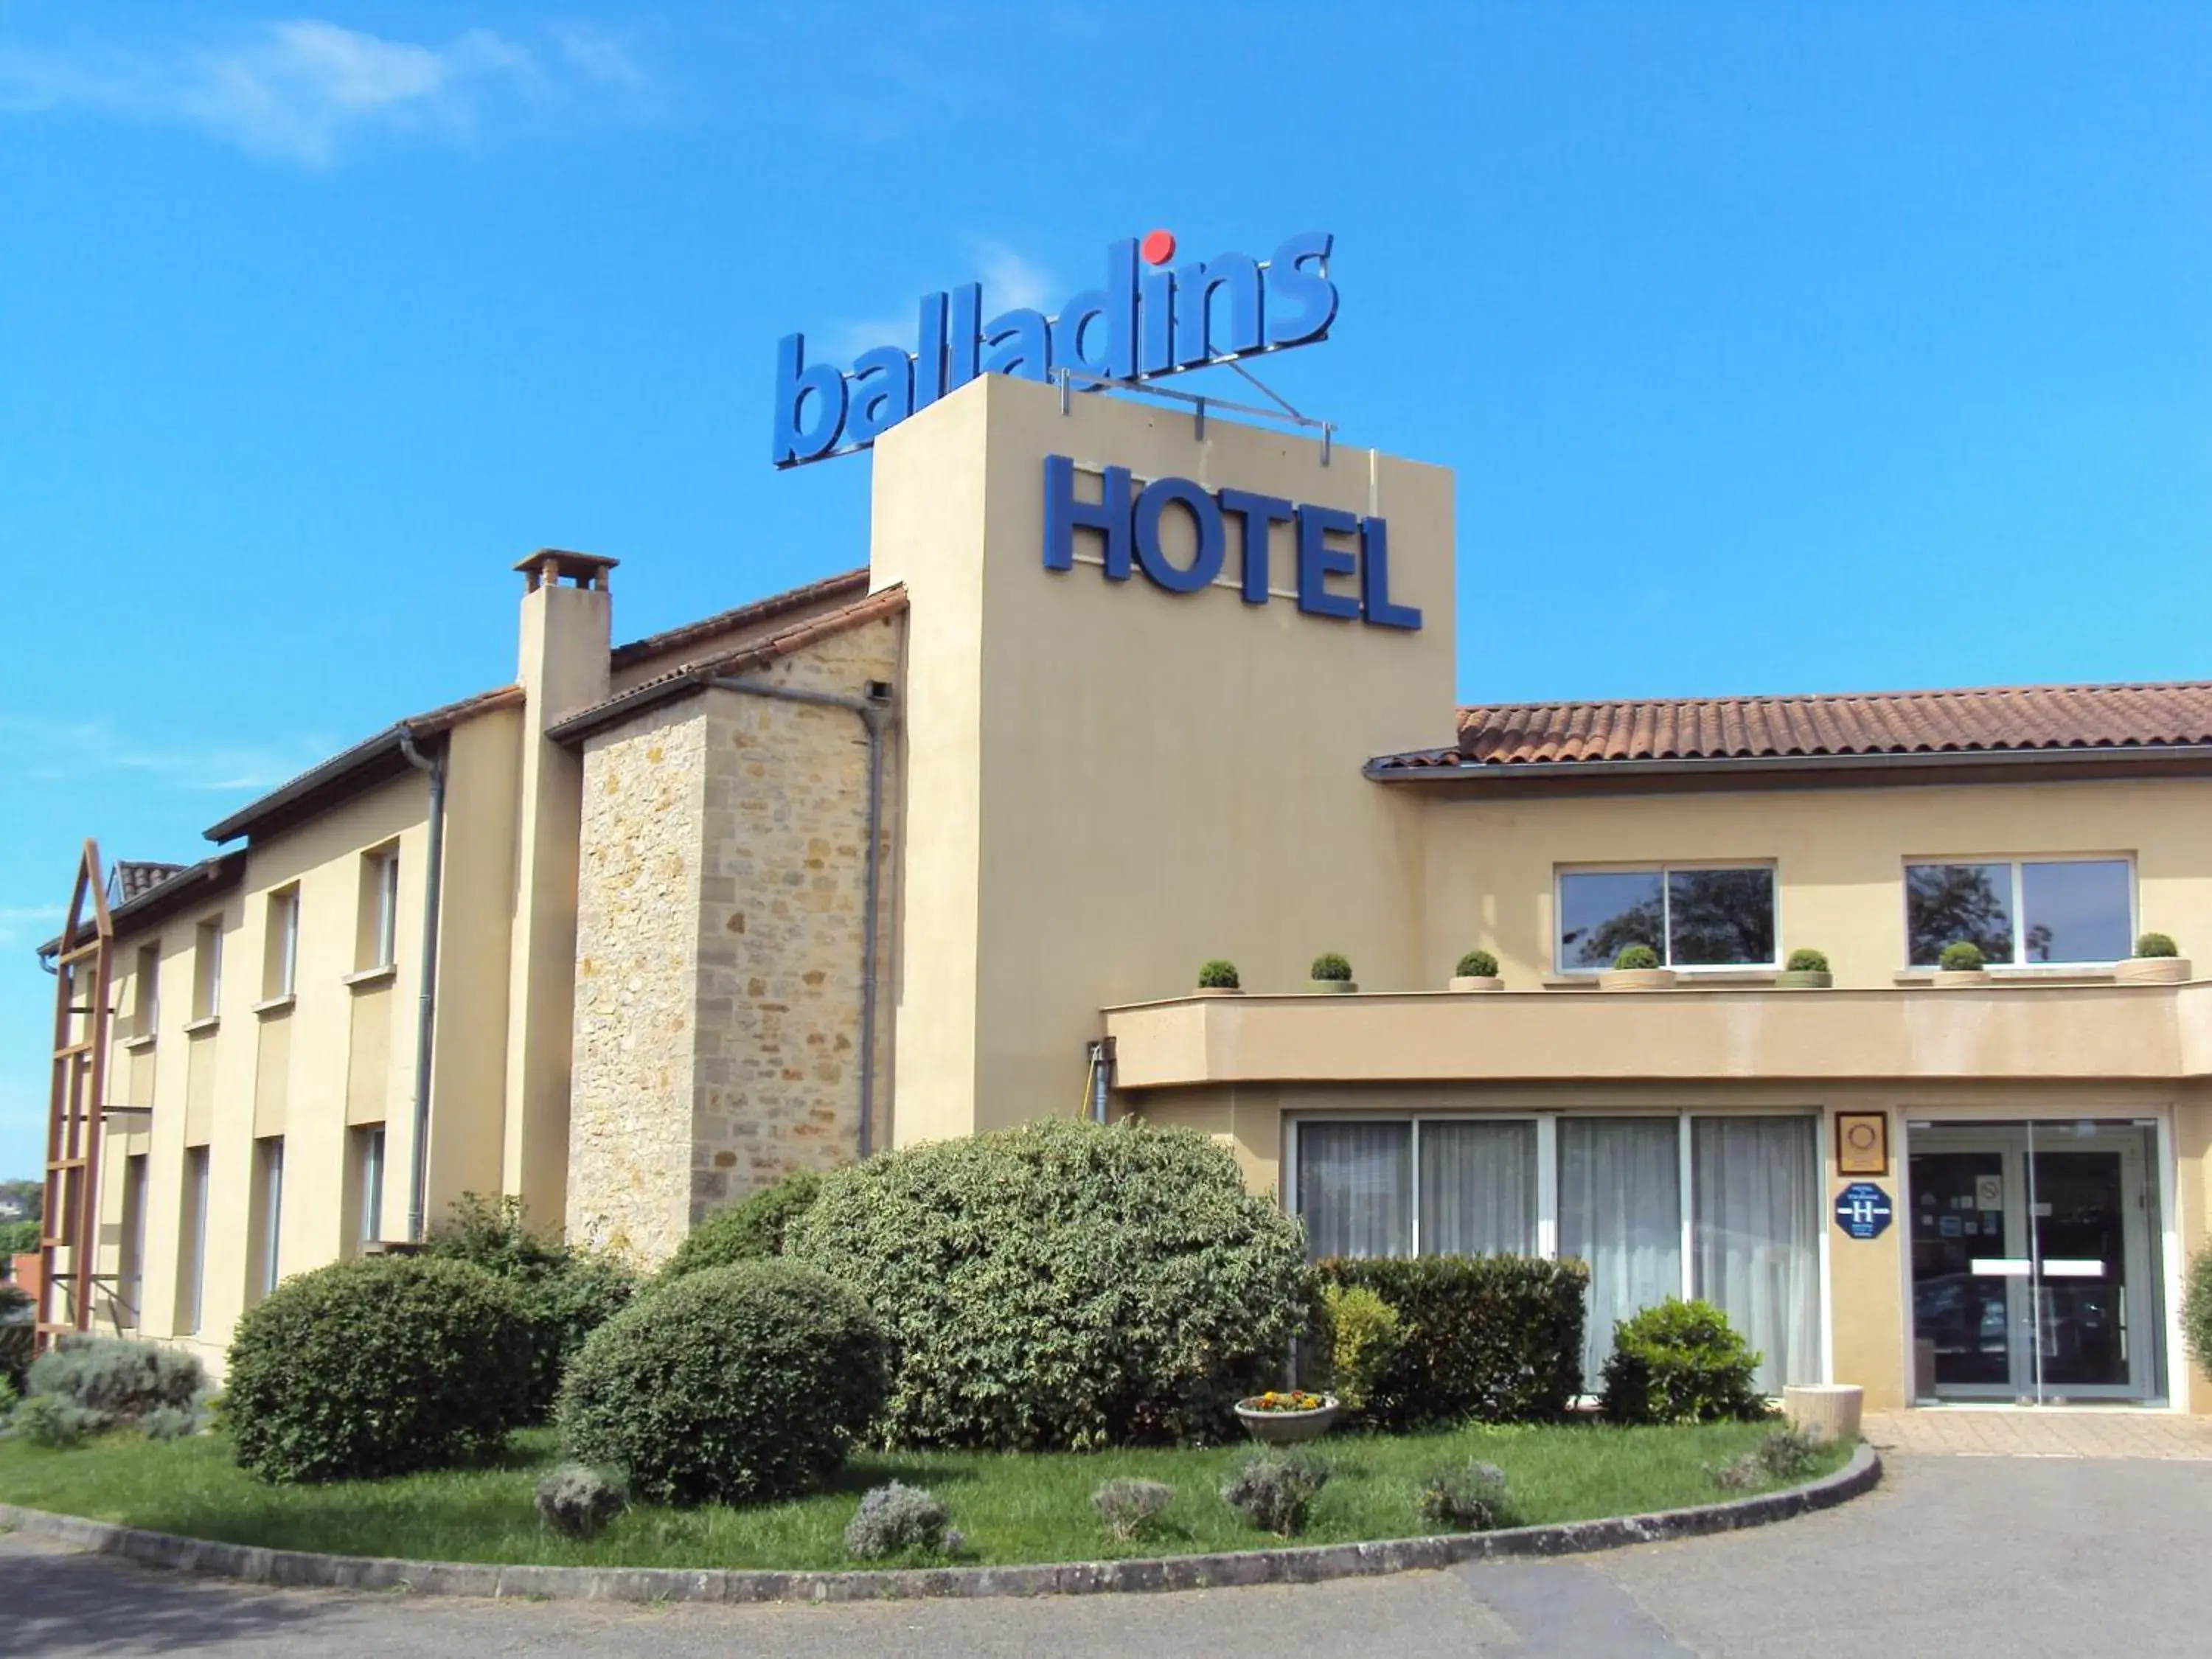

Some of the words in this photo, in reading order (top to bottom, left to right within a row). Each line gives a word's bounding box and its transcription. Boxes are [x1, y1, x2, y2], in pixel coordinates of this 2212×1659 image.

[772, 229, 1339, 467] balladins
[1043, 454, 1422, 630] HOTEL
[1853, 1200, 1873, 1222] H
